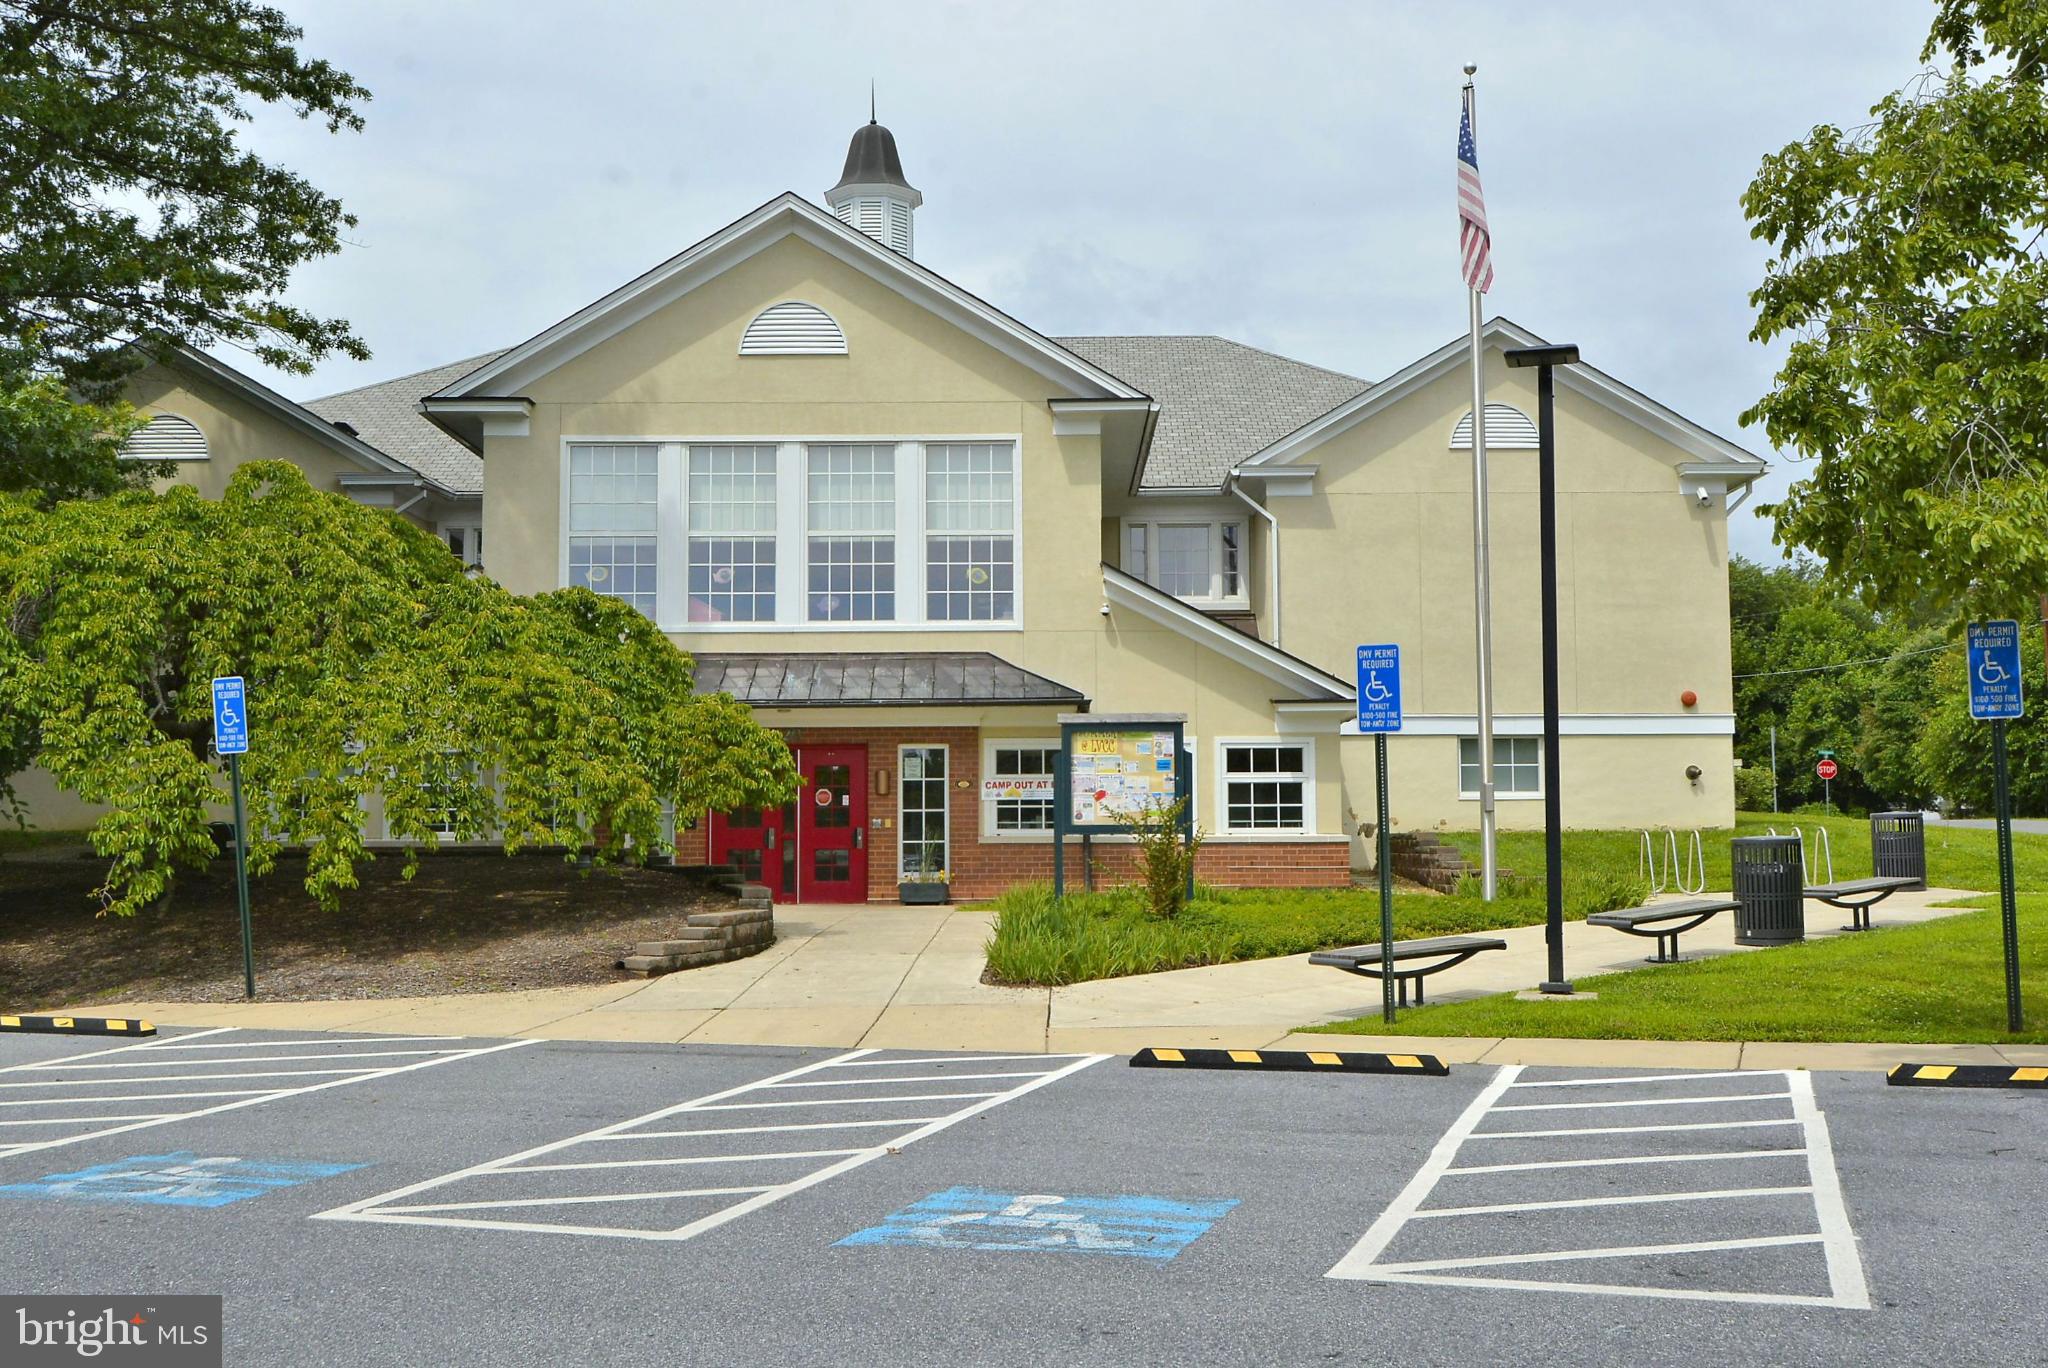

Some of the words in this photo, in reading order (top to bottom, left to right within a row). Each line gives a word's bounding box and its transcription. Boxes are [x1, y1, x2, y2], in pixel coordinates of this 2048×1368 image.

[1988, 626, 2014, 636] PERMIT
[1974, 637, 2011, 648] REQUIRED
[1359, 650, 1372, 658] DMV
[1374, 649, 1397, 658] PERMIT
[1362, 659, 1394, 669] REQUIRED
[1983, 685, 2008, 693] PENALTY
[2005, 694, 2017, 702] FINE
[1369, 703, 1390, 711] PENALTY
[2004, 703, 2020, 711] ZONE
[1387, 719, 1400, 727] ZONE
[1818, 765, 1836, 774] STOP
[985, 781, 1012, 789] CAMP
[1014, 780, 1034, 789] OUT
[1036, 780, 1048, 789] AT
